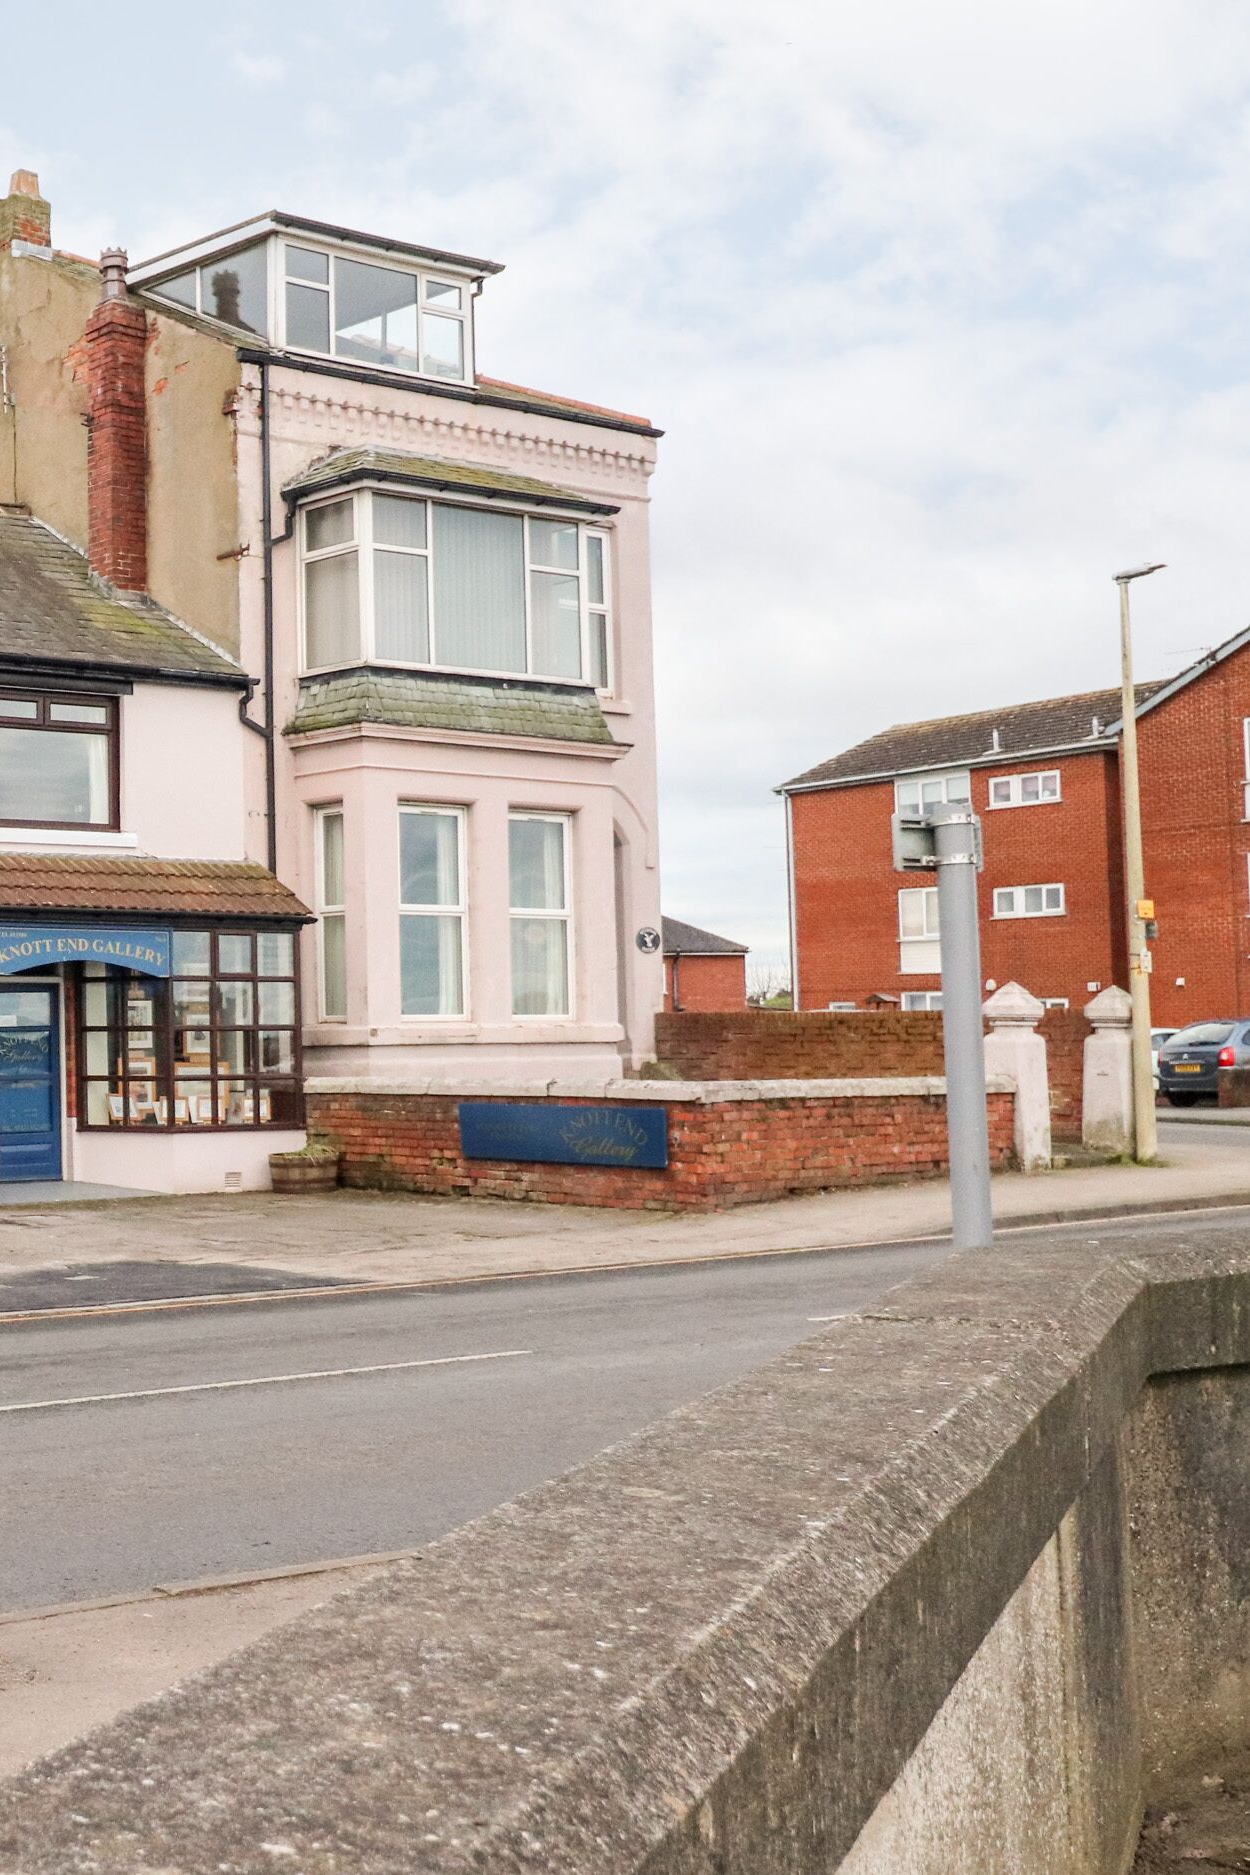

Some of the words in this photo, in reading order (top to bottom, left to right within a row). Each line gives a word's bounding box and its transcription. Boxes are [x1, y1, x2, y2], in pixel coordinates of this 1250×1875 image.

[56, 937, 89, 952] END
[92, 938, 165, 967] GALLERY
[615, 1111, 648, 1145] END
